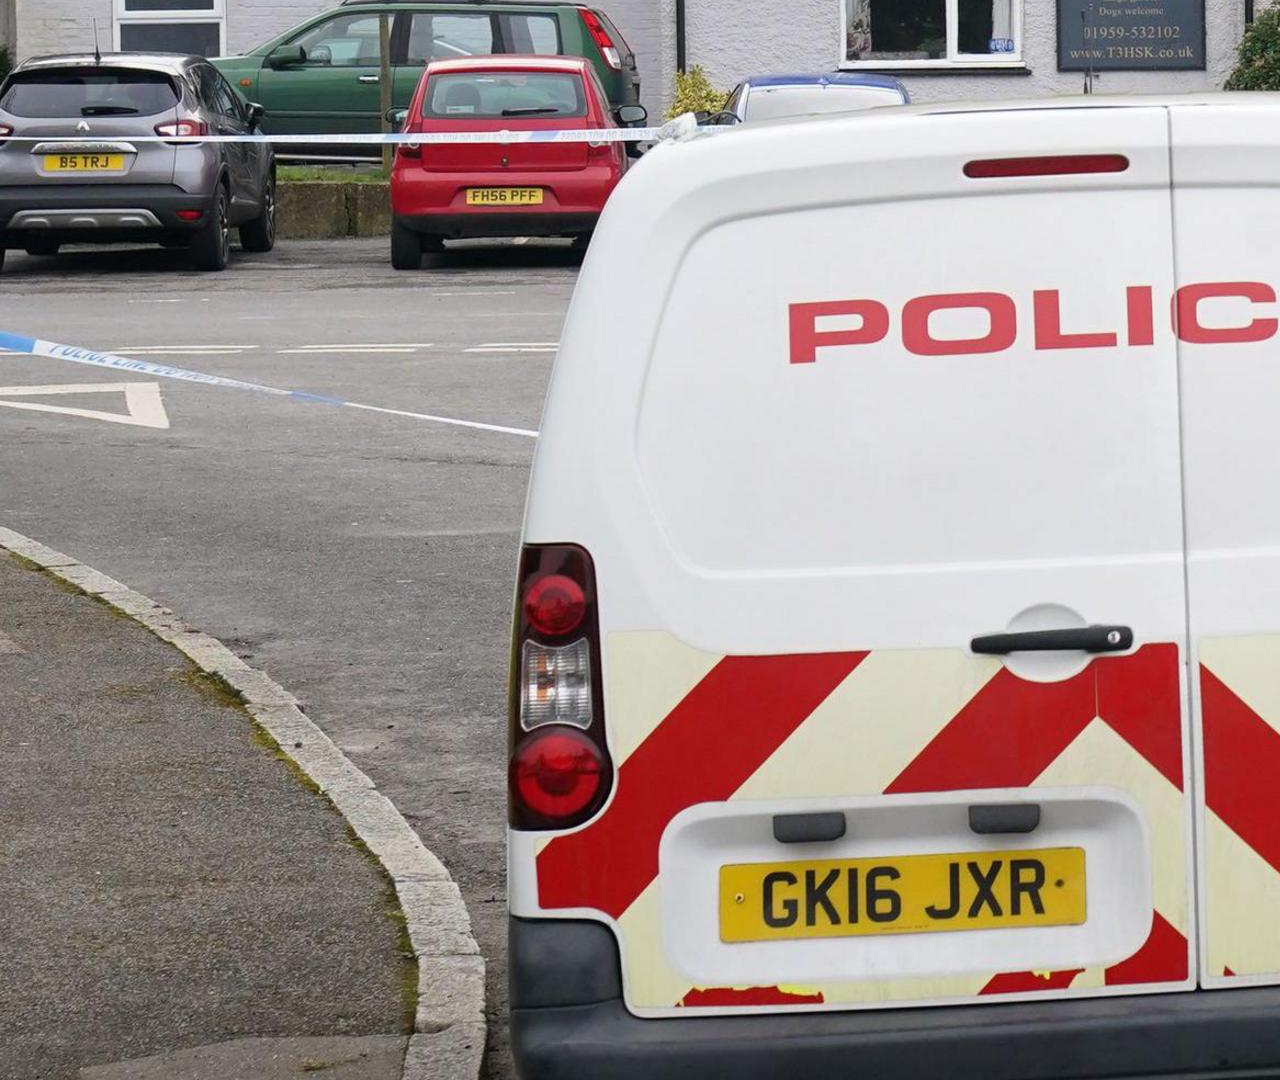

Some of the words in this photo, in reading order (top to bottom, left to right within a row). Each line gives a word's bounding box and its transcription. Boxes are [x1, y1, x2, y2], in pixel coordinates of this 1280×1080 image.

[1099, 7, 1122, 17] Dogs
[1124, 7, 1164, 16] welcome
[1084, 26, 1180, 39] 01959-532102
[1070, 46, 1193, 59] www.T3HSK.co.uk
[82, 156, 109, 168] TRJ
[472, 190, 507, 202] FH56
[511, 190, 537, 201] PFF
[762, 866, 901, 928] GK16
[925, 859, 1045, 919] JXR
